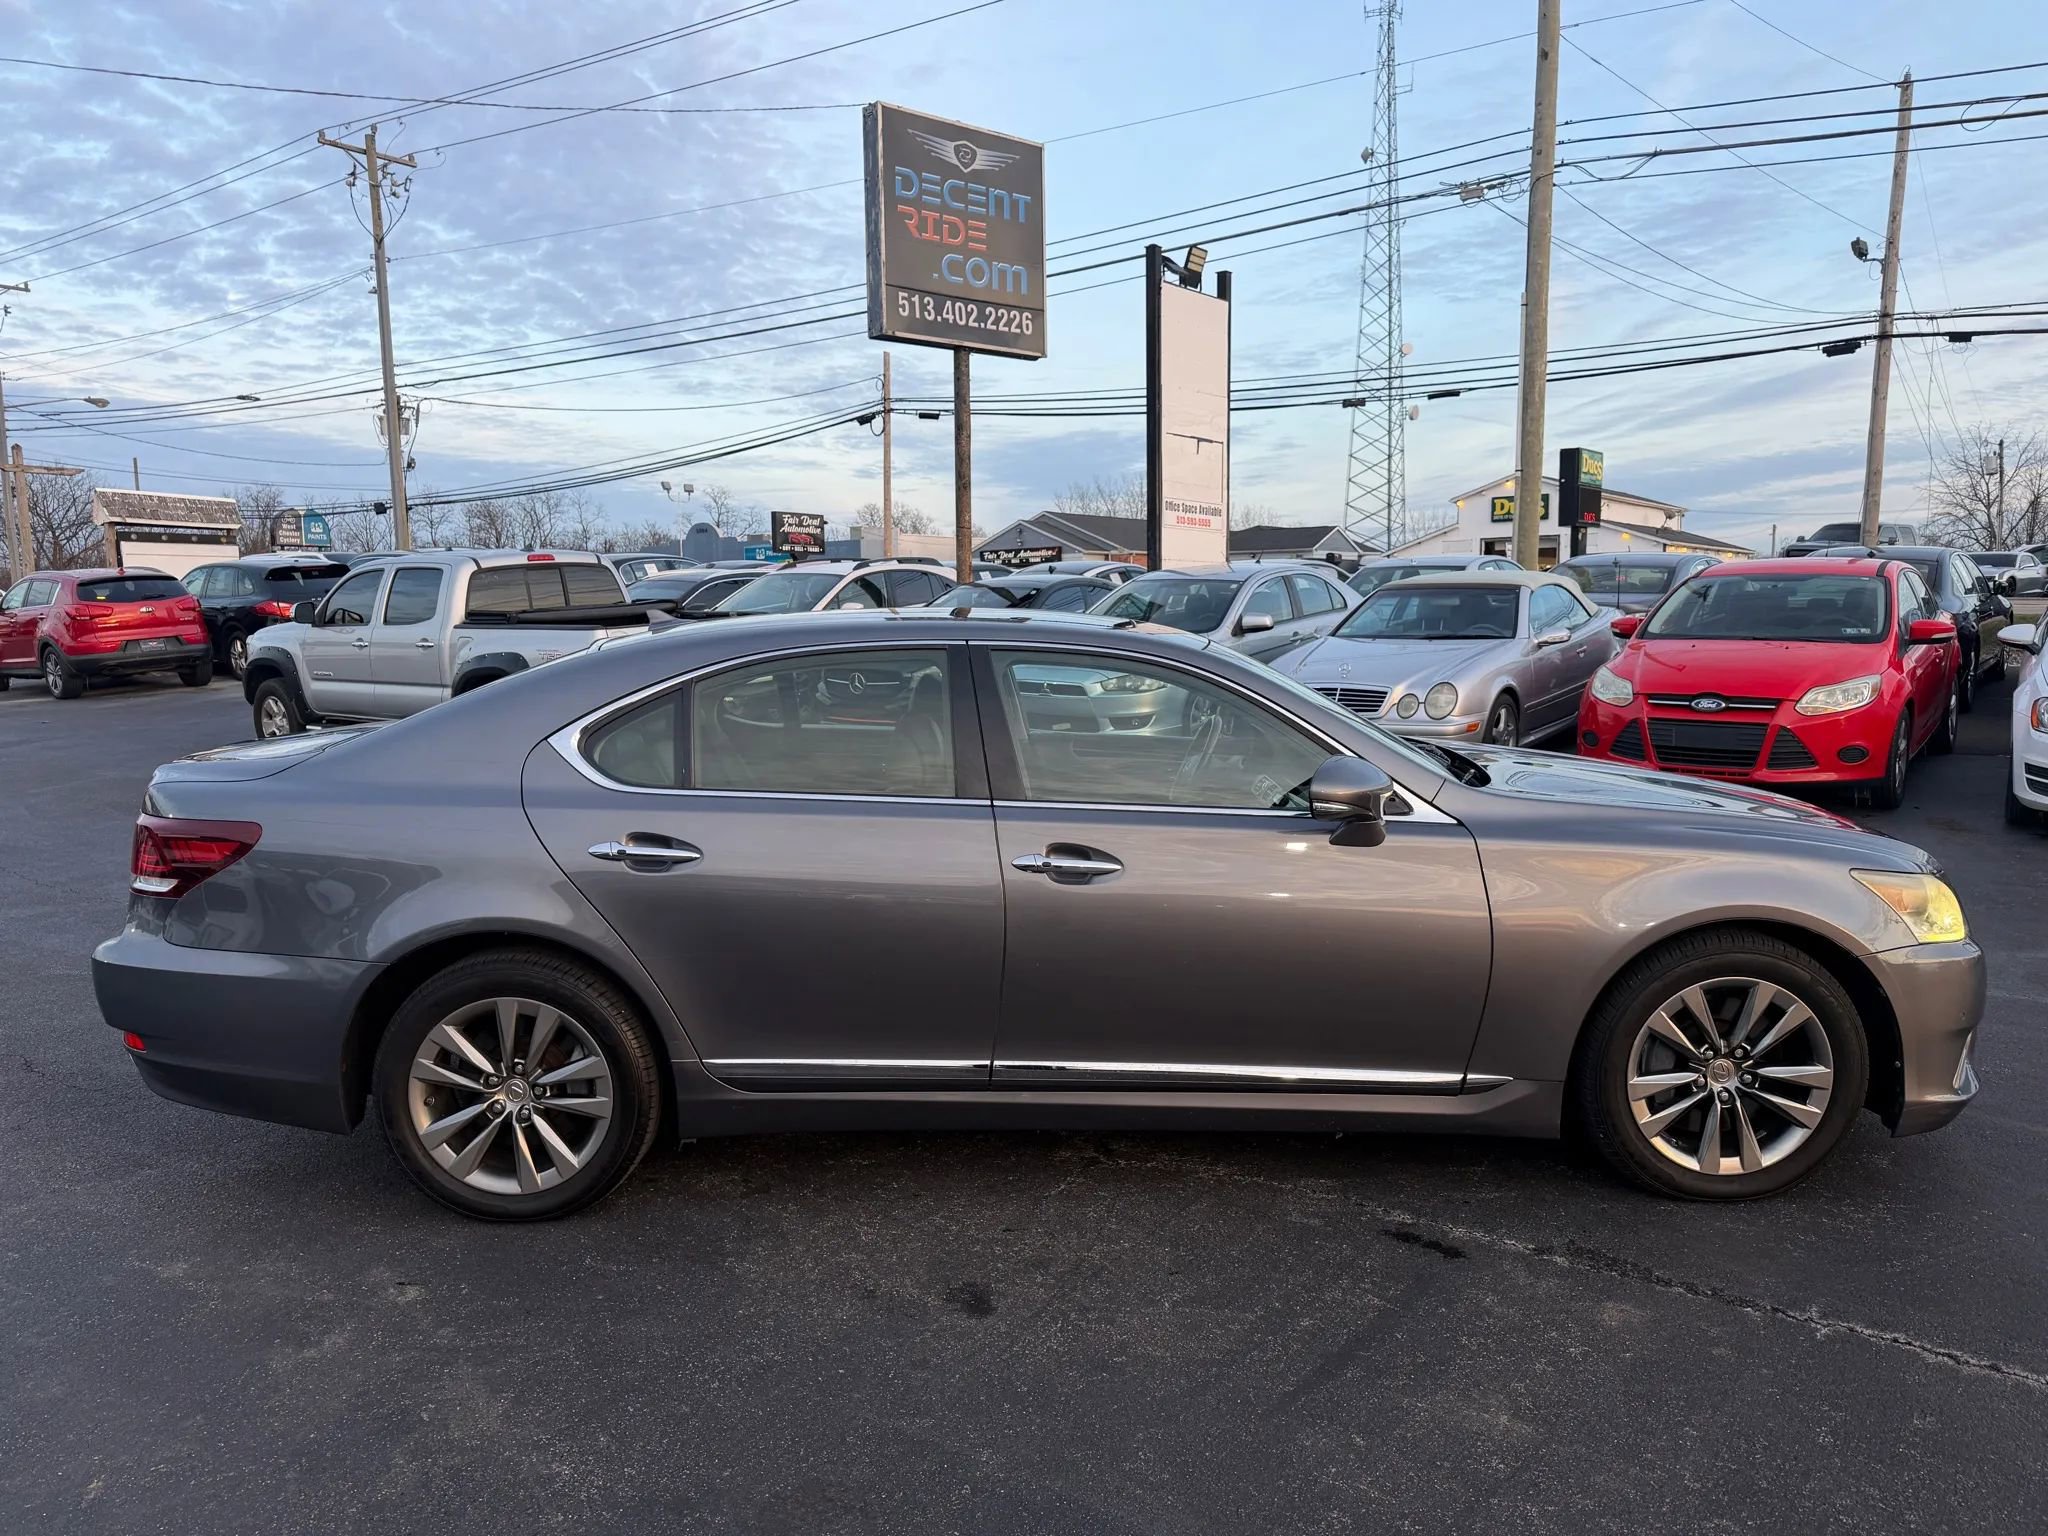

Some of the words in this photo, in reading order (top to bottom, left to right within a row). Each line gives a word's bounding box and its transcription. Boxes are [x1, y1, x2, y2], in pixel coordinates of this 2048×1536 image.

[895, 166, 1031, 223] DECENT
[897, 204, 987, 251] RIDE
[898, 291, 1033, 335] 513.402.2226
[1165, 500, 1180, 512] Office
[1181, 502, 1197, 515] Space
[1199, 504, 1222, 517] Available
[782, 514, 799, 524] Fair
[801, 516, 820, 525] Deal
[779, 524, 822, 534] Automotive
[983, 552, 996, 560] Fair
[998, 551, 1014, 559] Deal
[1016, 549, 1053, 558] Automotive
